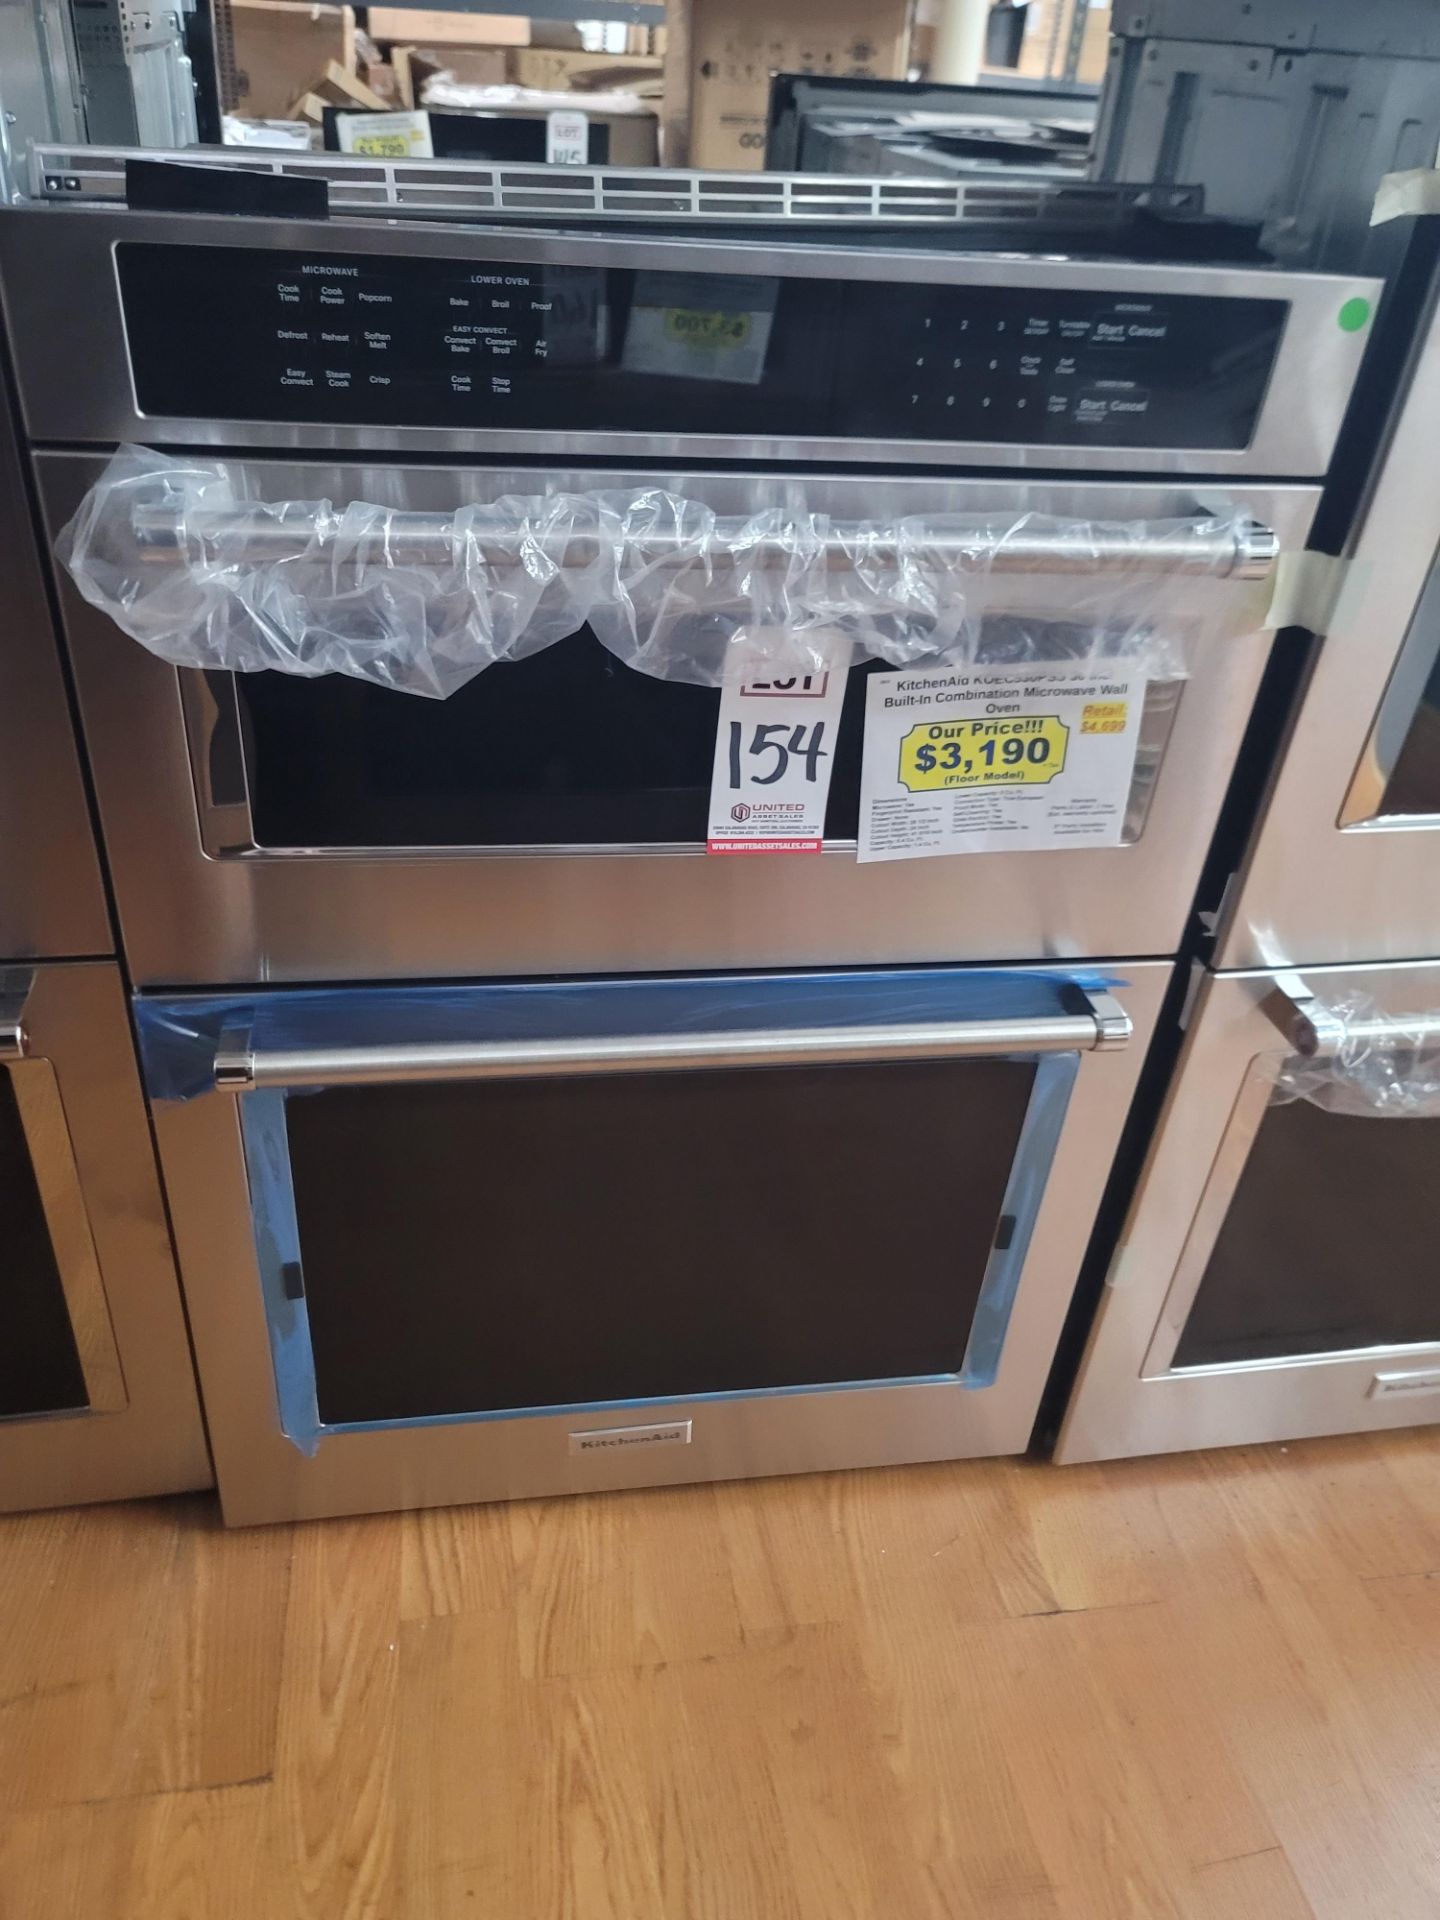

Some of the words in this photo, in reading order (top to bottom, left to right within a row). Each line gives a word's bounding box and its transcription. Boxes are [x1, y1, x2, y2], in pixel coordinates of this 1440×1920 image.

[557, 127, 578, 138] LOT
[302, 265, 359, 277] MICROWAVE
[471, 275, 503, 285] LOWER
[504, 276, 530, 286] OVEN
[277, 283, 300, 293] Cook
[321, 286, 343, 296] Cook
[279, 293, 300, 302] Time
[320, 295, 345, 304] Power
[358, 293, 392, 303] Popcorn
[449, 297, 470, 306] Bake
[491, 299, 510, 309] Broil
[530, 301, 553, 311] Proof
[452, 325, 472, 333] EASY
[472, 326, 508, 335] CONVECT
[960, 319, 969, 331] 2
[997, 320, 1006, 332] 3
[1096, 322, 1125, 335] Start
[1128, 324, 1168, 338] Cancel
[277, 329, 309, 340] Defrost
[321, 332, 350, 342] Reheat
[363, 331, 391, 341] Soften
[444, 335, 477, 345] Convect
[484, 337, 518, 347] Convect
[369, 341, 387, 350] Melt
[450, 344, 471, 353] Bake
[492, 346, 511, 355] Broil
[534, 347, 548, 358] Fry
[286, 367, 306, 378] Easy
[325, 370, 351, 379] Steam
[280, 377, 314, 386] Convect
[328, 379, 350, 388] Cook
[369, 375, 391, 386] Crisp
[450, 375, 472, 384] Cook
[491, 376, 511, 386] Stop
[451, 383, 472, 392] Time
[491, 385, 511, 393] Time
[1079, 398, 1107, 410] Start
[1109, 400, 1149, 412] Cancel
[897, 676, 969, 692] KitchenAid
[884, 694, 932, 708] Built-In
[935, 688, 1020, 703] Combination
[1023, 686, 1096, 698] Microwave
[1099, 683, 1128, 695] Wall
[985, 703, 1020, 714] Oven
[928, 726, 965, 739] Our
[971, 720, 1044, 737] Price!!!
[729, 721, 828, 789] 154
[914, 737, 1050, 774] $3,190
[944, 774, 980, 786] (Floor
[983, 770, 1025, 781] Model)
[752, 803, 805, 811] UNITED
[581, 1431, 681, 1449] KitchenAid
